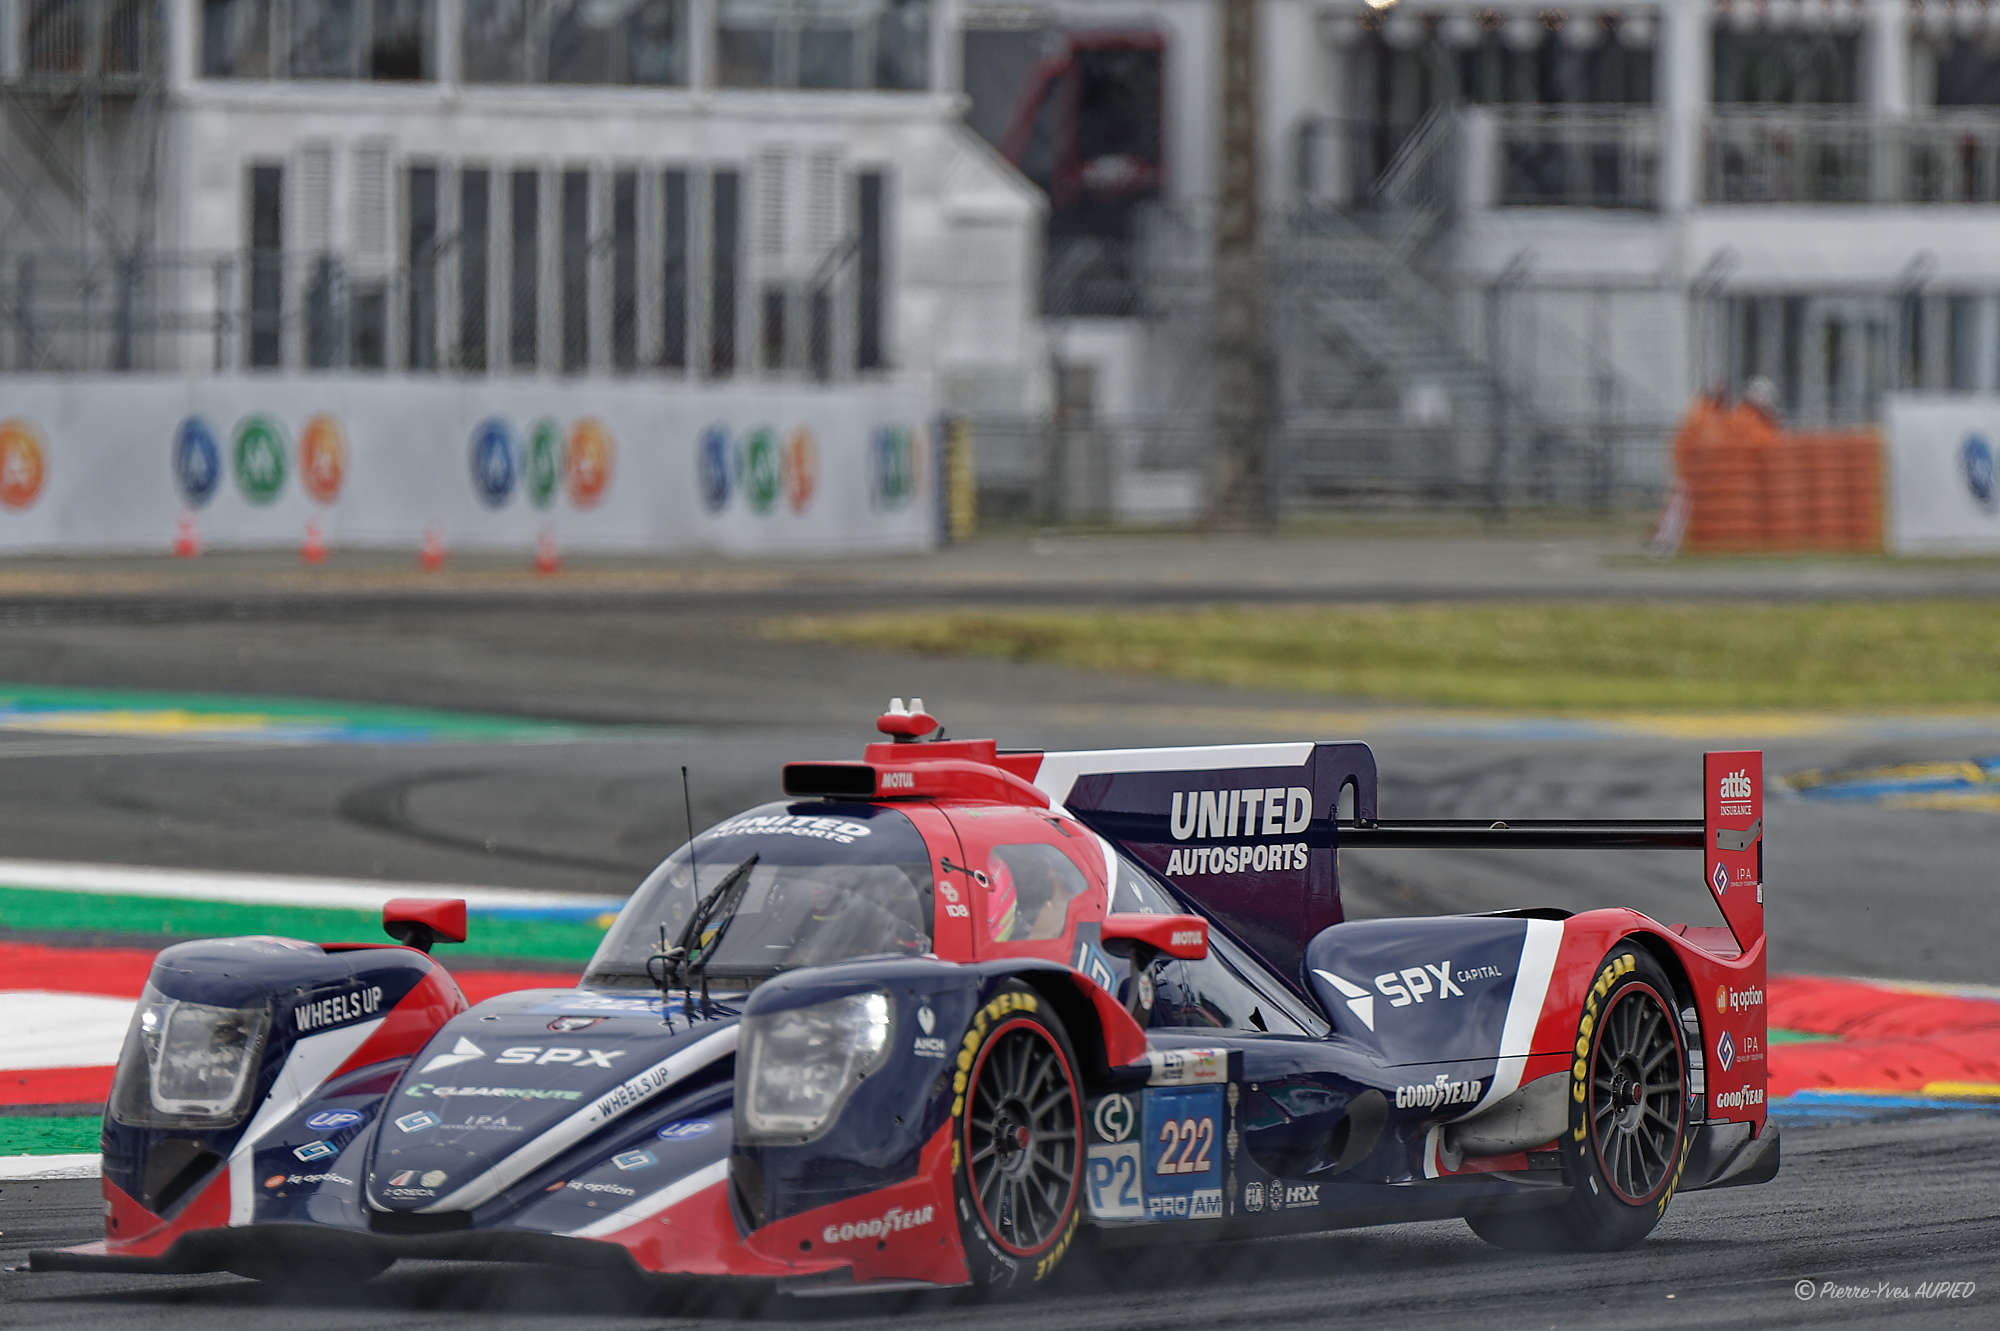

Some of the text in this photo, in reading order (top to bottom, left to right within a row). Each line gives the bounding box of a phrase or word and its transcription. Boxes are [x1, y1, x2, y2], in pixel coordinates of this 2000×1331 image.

[882, 772, 914, 788] MOTUL
[1170, 786, 1313, 841] UNITED
[1720, 805, 1752, 816] INSURANCE
[717, 815, 872, 837] UNITED
[1165, 842, 1309, 876] AUTOSPORTS
[1736, 868, 1752, 880] IPA
[1171, 931, 1203, 946] MOTUL
[1374, 961, 1502, 1008] SPX CAPITAL
[295, 986, 383, 1032] WHEELS UP
[1729, 984, 1763, 1012] iq option
[1743, 1036, 1759, 1053] IPA
[494, 1046, 628, 1069] SPX
[596, 1066, 670, 1118] WHEELS UP
[1395, 1073, 1482, 1112] GOODYEAR
[1716, 1084, 1764, 1111] GOODYEAR
[309, 1112, 360, 1127] UP
[660, 1123, 713, 1136] UP
[1155, 1116, 1214, 1176] 222
[584, 1182, 636, 1196] option
[1088, 1155, 1139, 1209] P2
[1286, 1185, 1320, 1203] HRX
[1150, 1195, 1221, 1217] PRO AM
[823, 1205, 934, 1243] GOODYEAR
